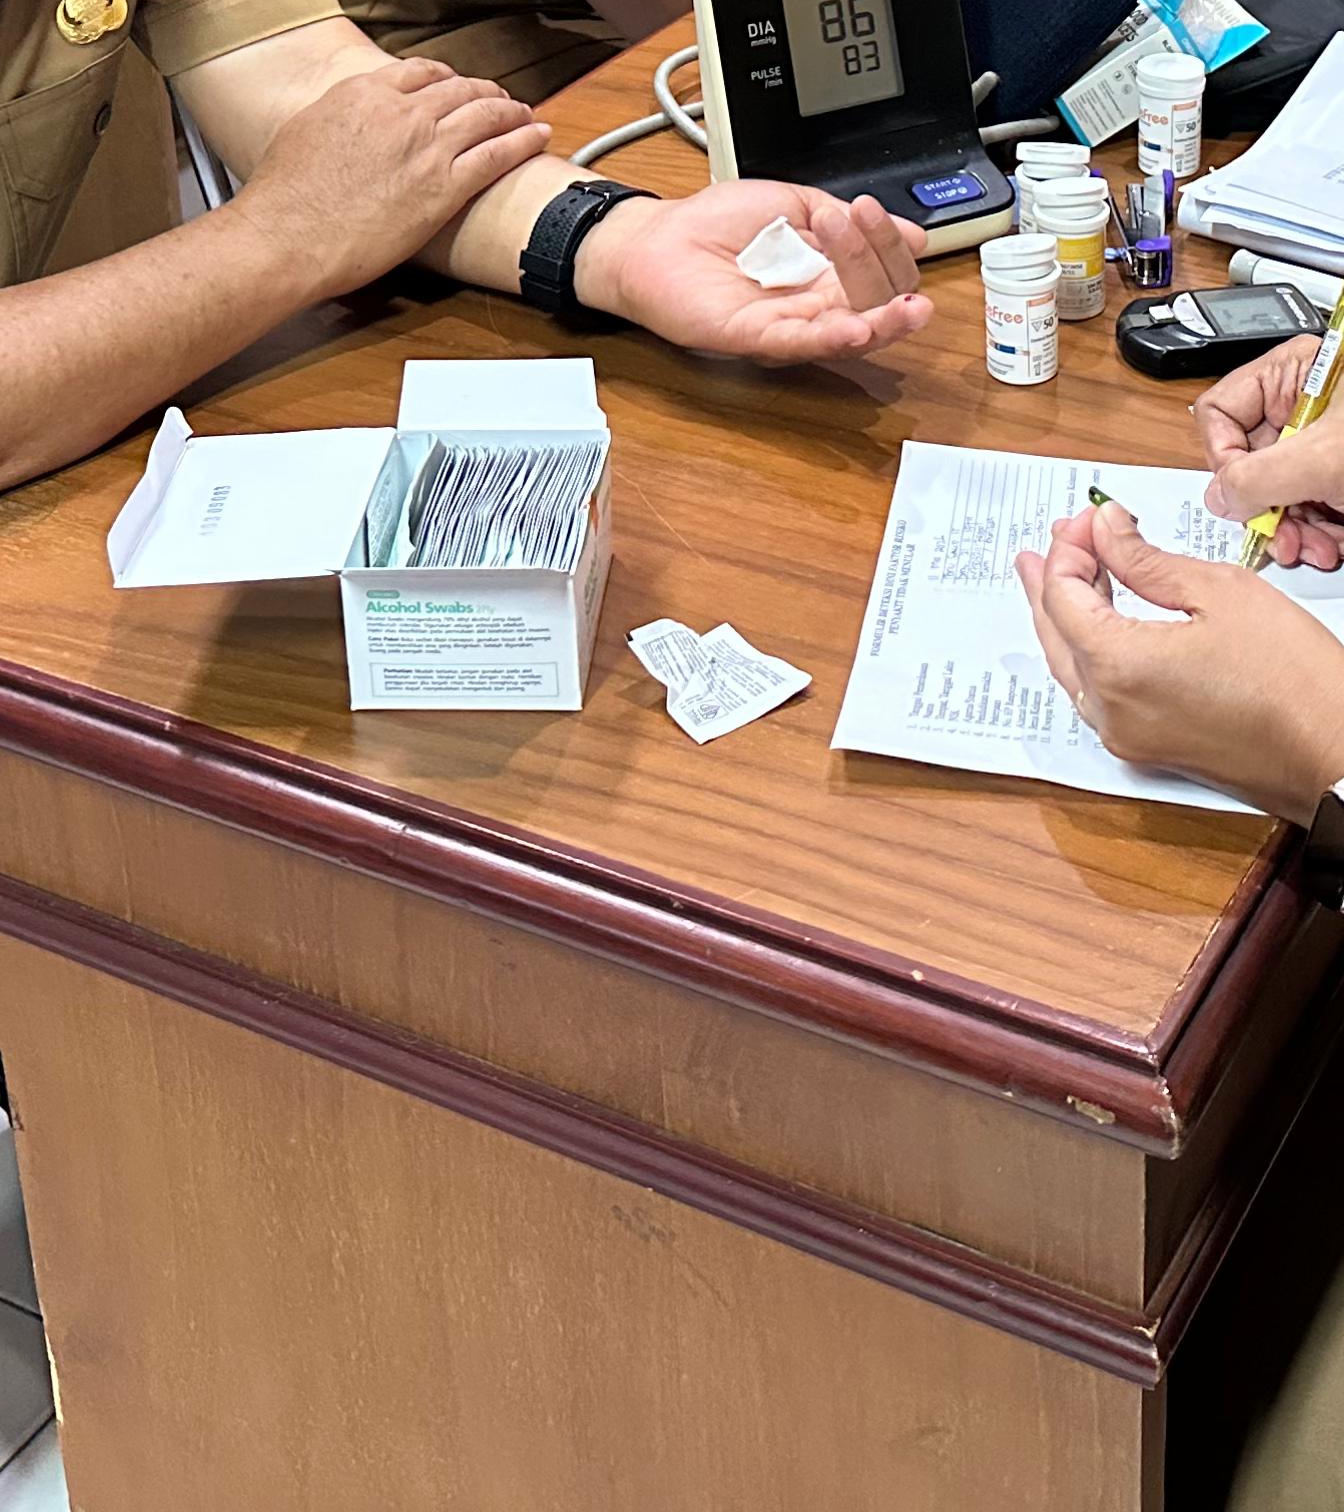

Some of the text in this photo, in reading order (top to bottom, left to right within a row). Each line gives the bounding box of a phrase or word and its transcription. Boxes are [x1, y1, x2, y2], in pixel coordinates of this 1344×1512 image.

[748, 20, 776, 38] DIA
[842, 40, 881, 76] 83
[750, 66, 781, 81] PULSE
[1043, 316, 1055, 330] 50
[366, 601, 421, 613] Alcohol
[425, 601, 474, 613] Swabs
